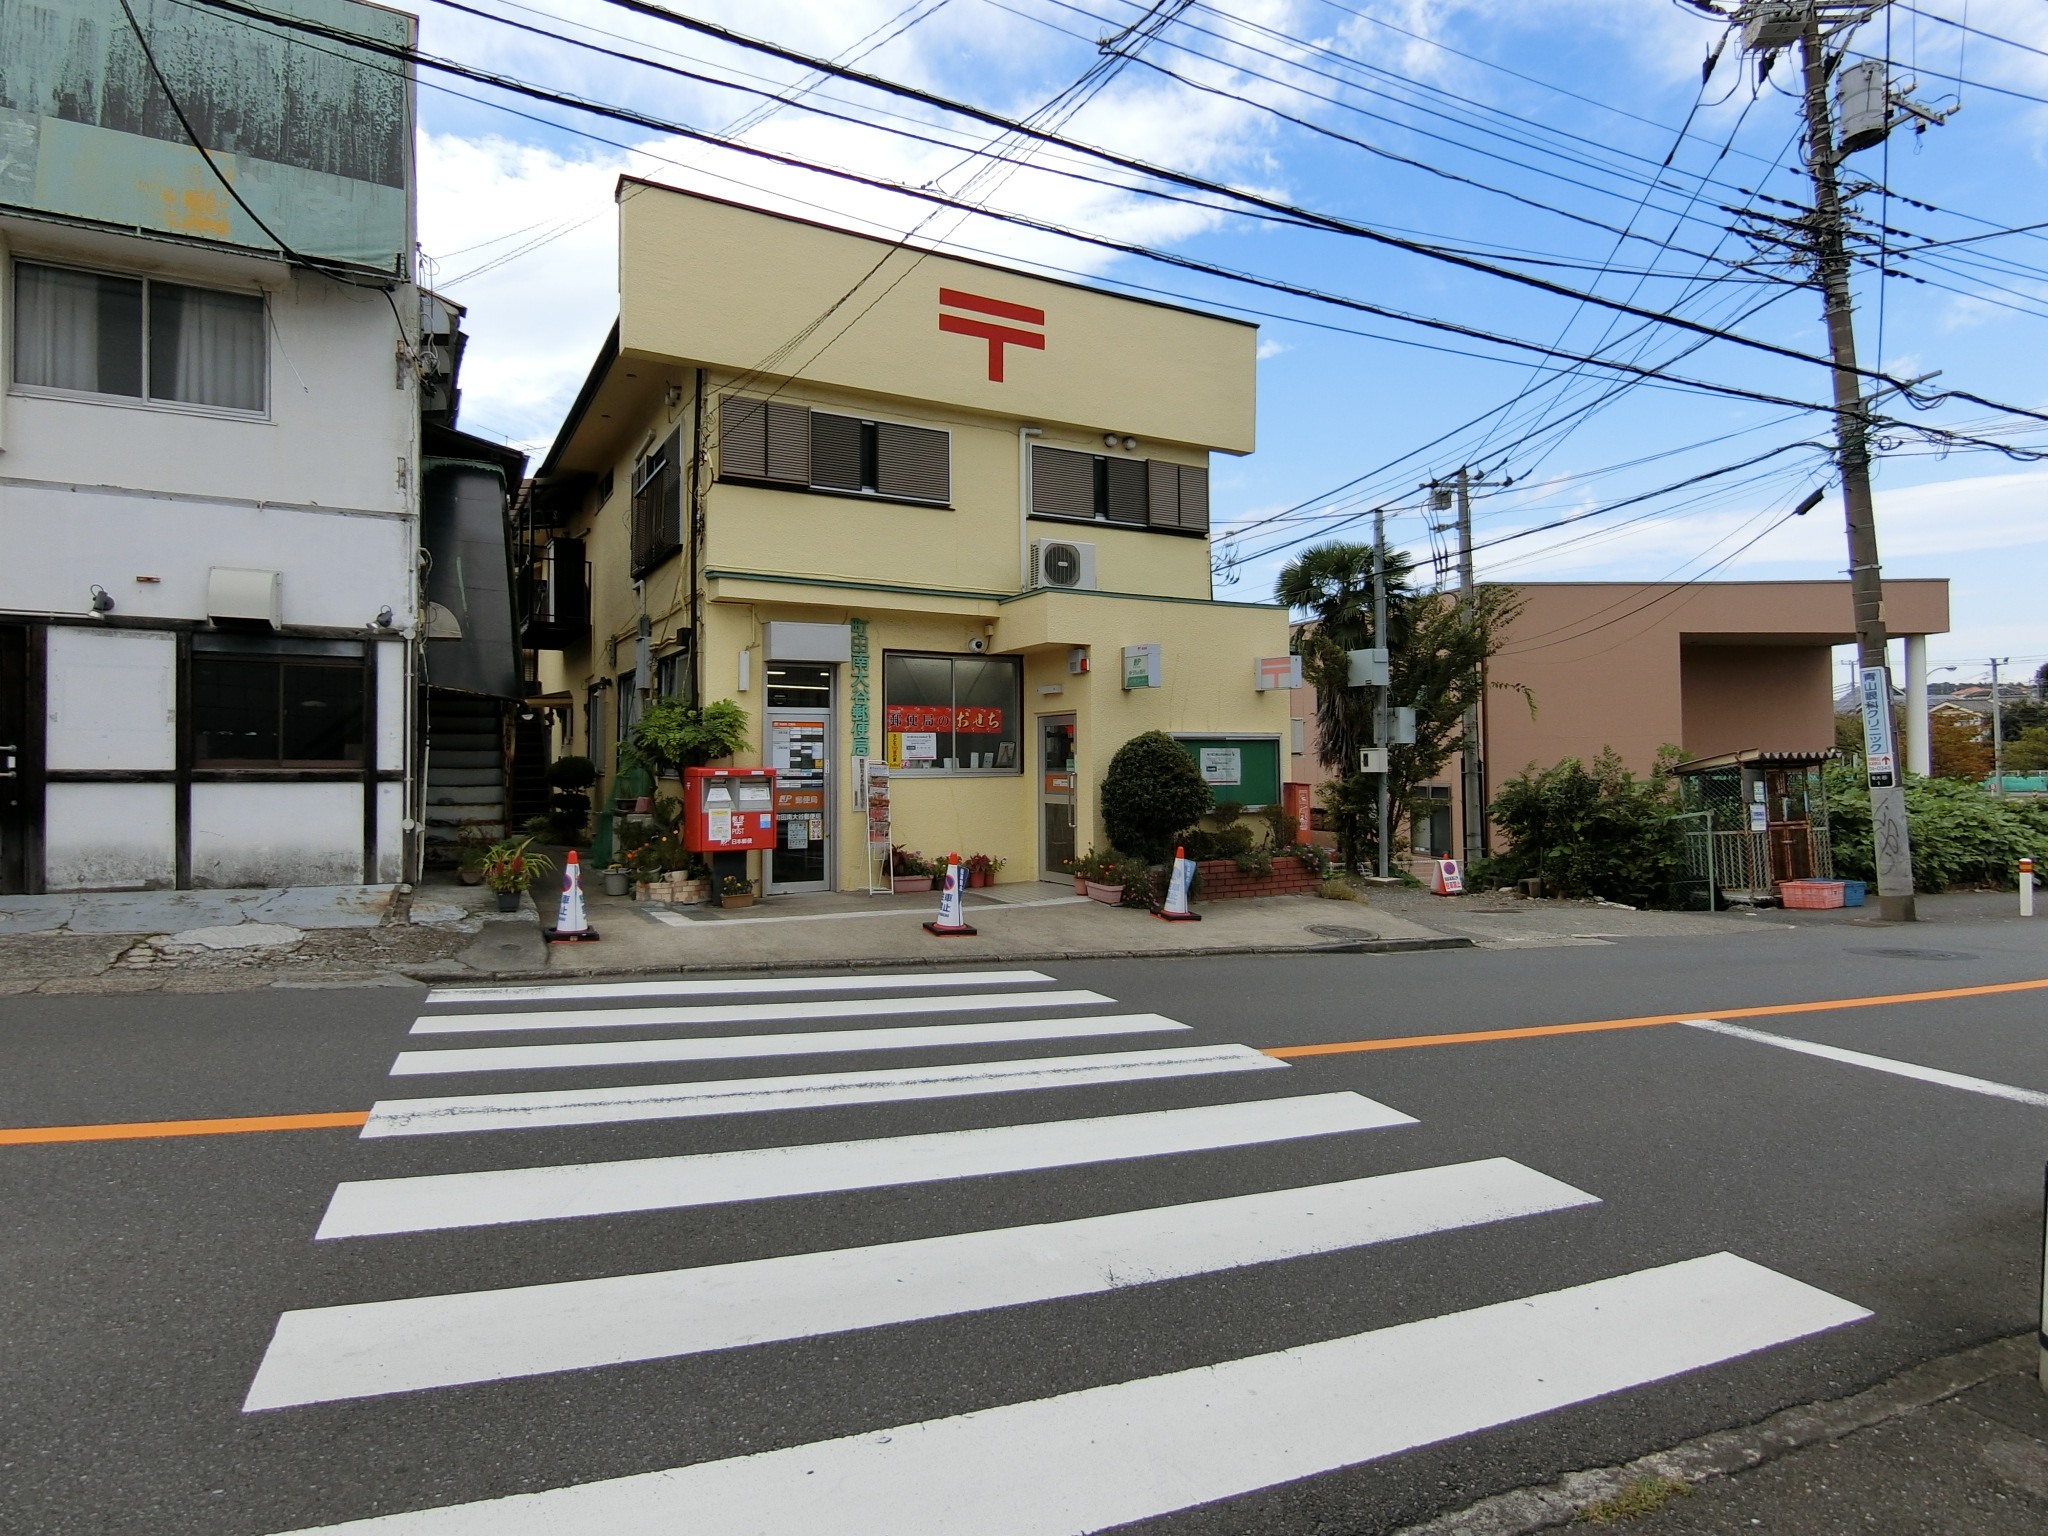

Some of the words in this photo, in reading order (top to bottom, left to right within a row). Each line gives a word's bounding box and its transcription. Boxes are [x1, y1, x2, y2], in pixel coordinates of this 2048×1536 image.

[851, 618, 869, 756] 町田南大谷郵便局
[1863, 672, 1883, 753] 青山眼科クリニック
